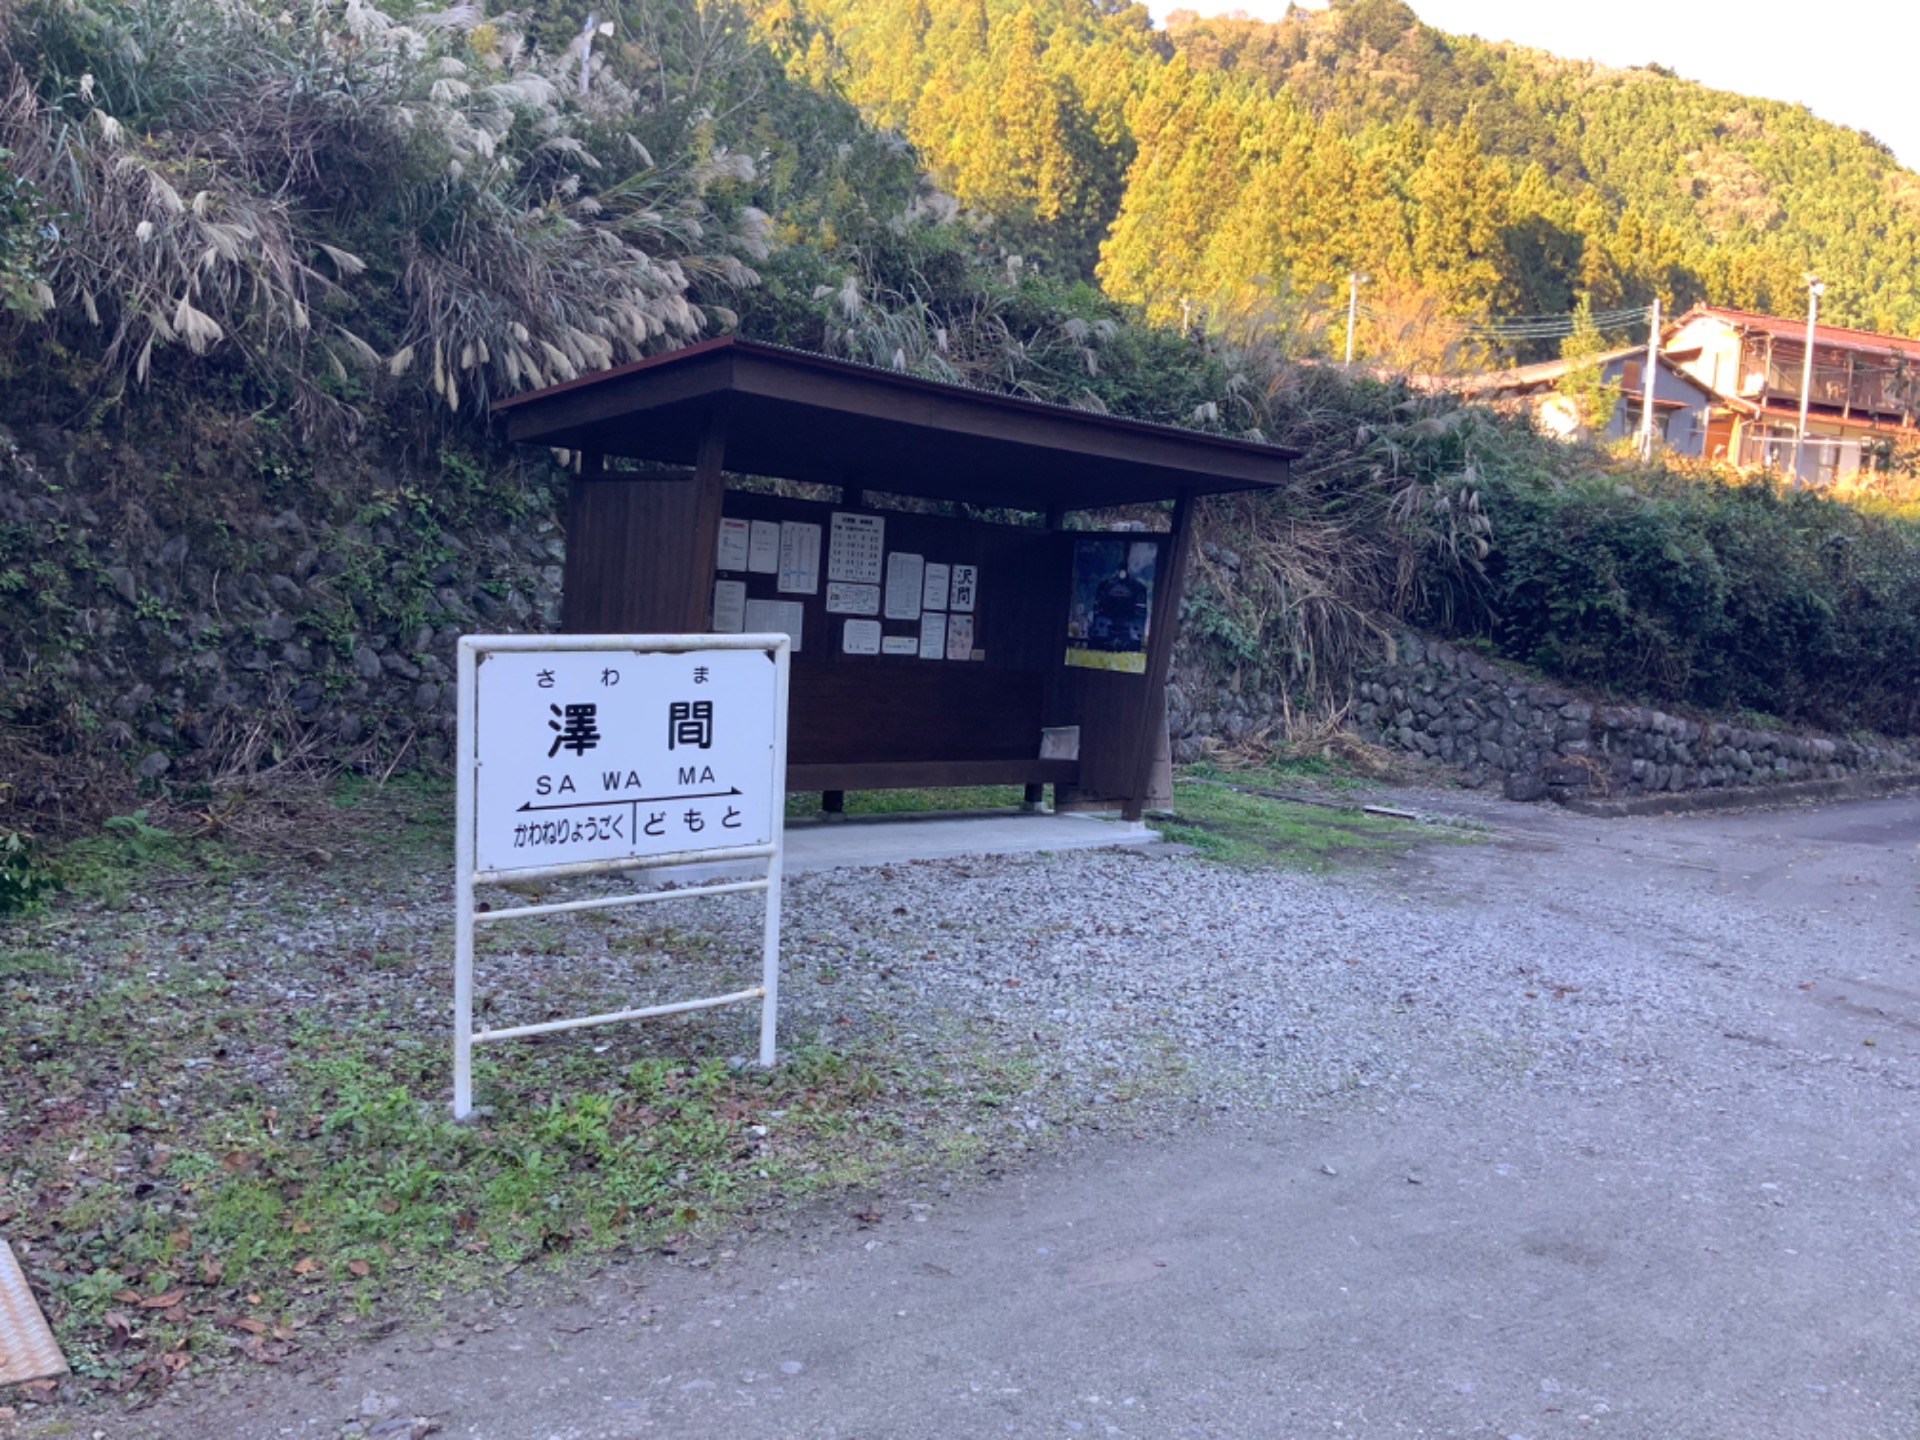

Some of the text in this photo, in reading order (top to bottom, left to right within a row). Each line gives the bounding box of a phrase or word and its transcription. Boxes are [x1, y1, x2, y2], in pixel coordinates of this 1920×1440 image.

[536, 666, 710, 689] さわま
[548, 700, 713, 758] 澤間
[536, 765, 715, 796] SA WA MA
[513, 814, 624, 848] かわねりょうごく
[643, 805, 743, 836] どもと
